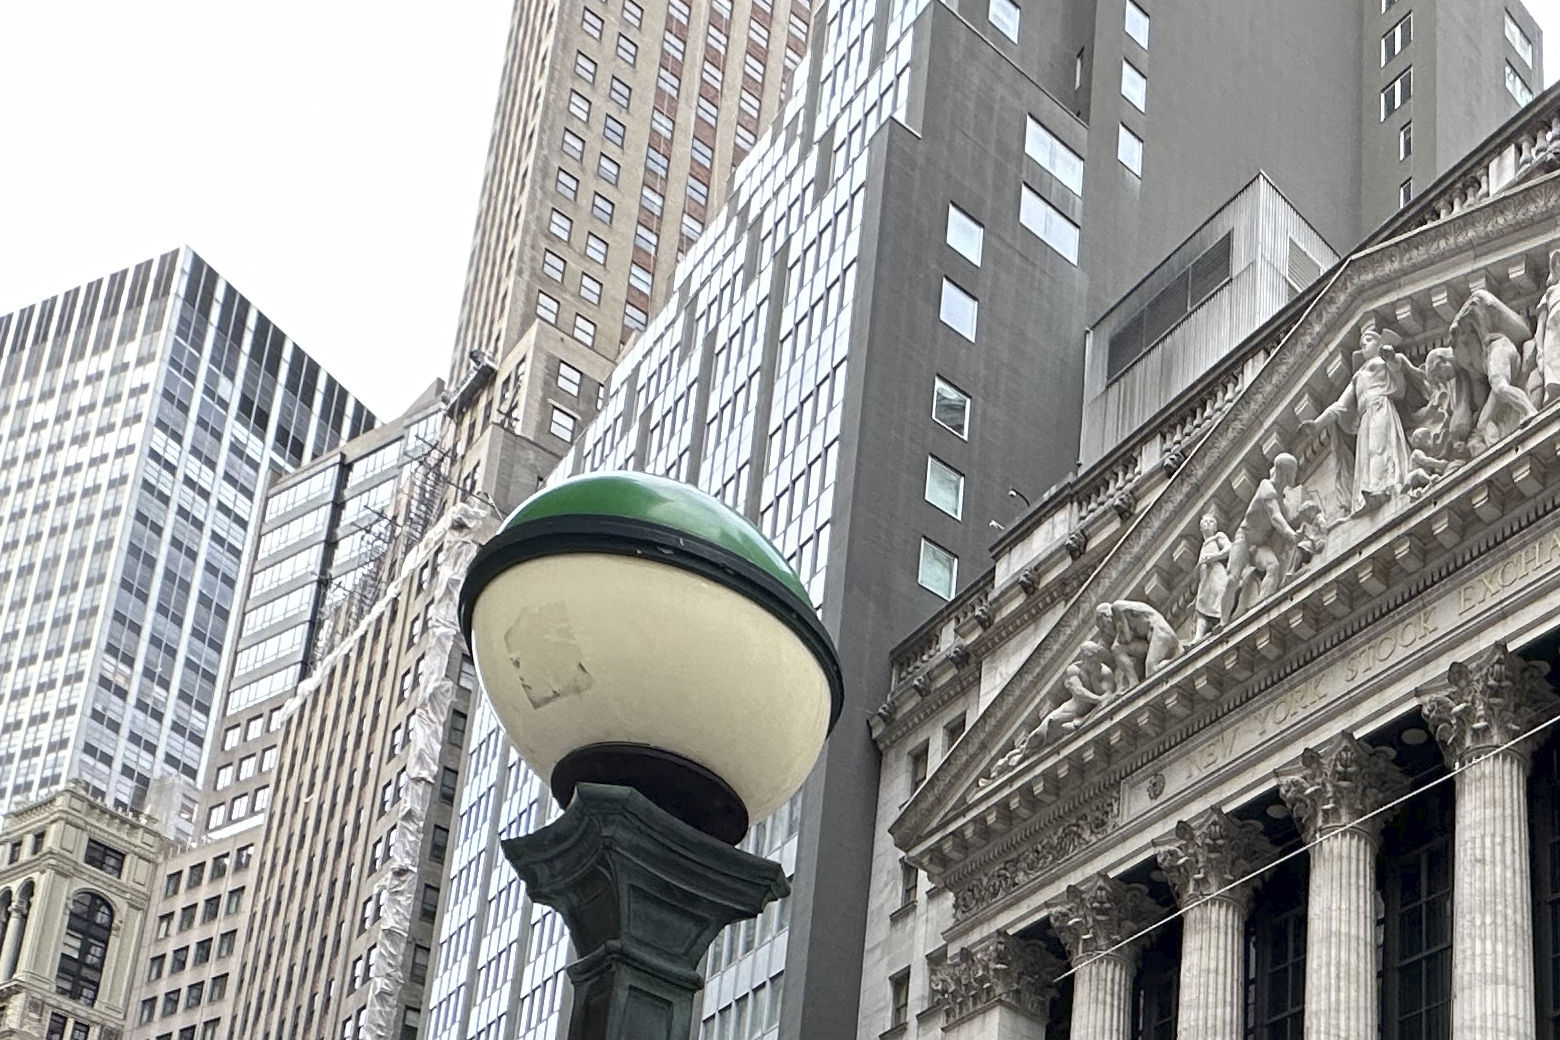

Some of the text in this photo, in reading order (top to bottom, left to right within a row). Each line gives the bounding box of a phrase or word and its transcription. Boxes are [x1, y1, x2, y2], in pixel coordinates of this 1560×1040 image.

[1186, 727, 1240, 780] NEW
[1254, 673, 1328, 736] YORK
[1344, 606, 1438, 682] STOCK
